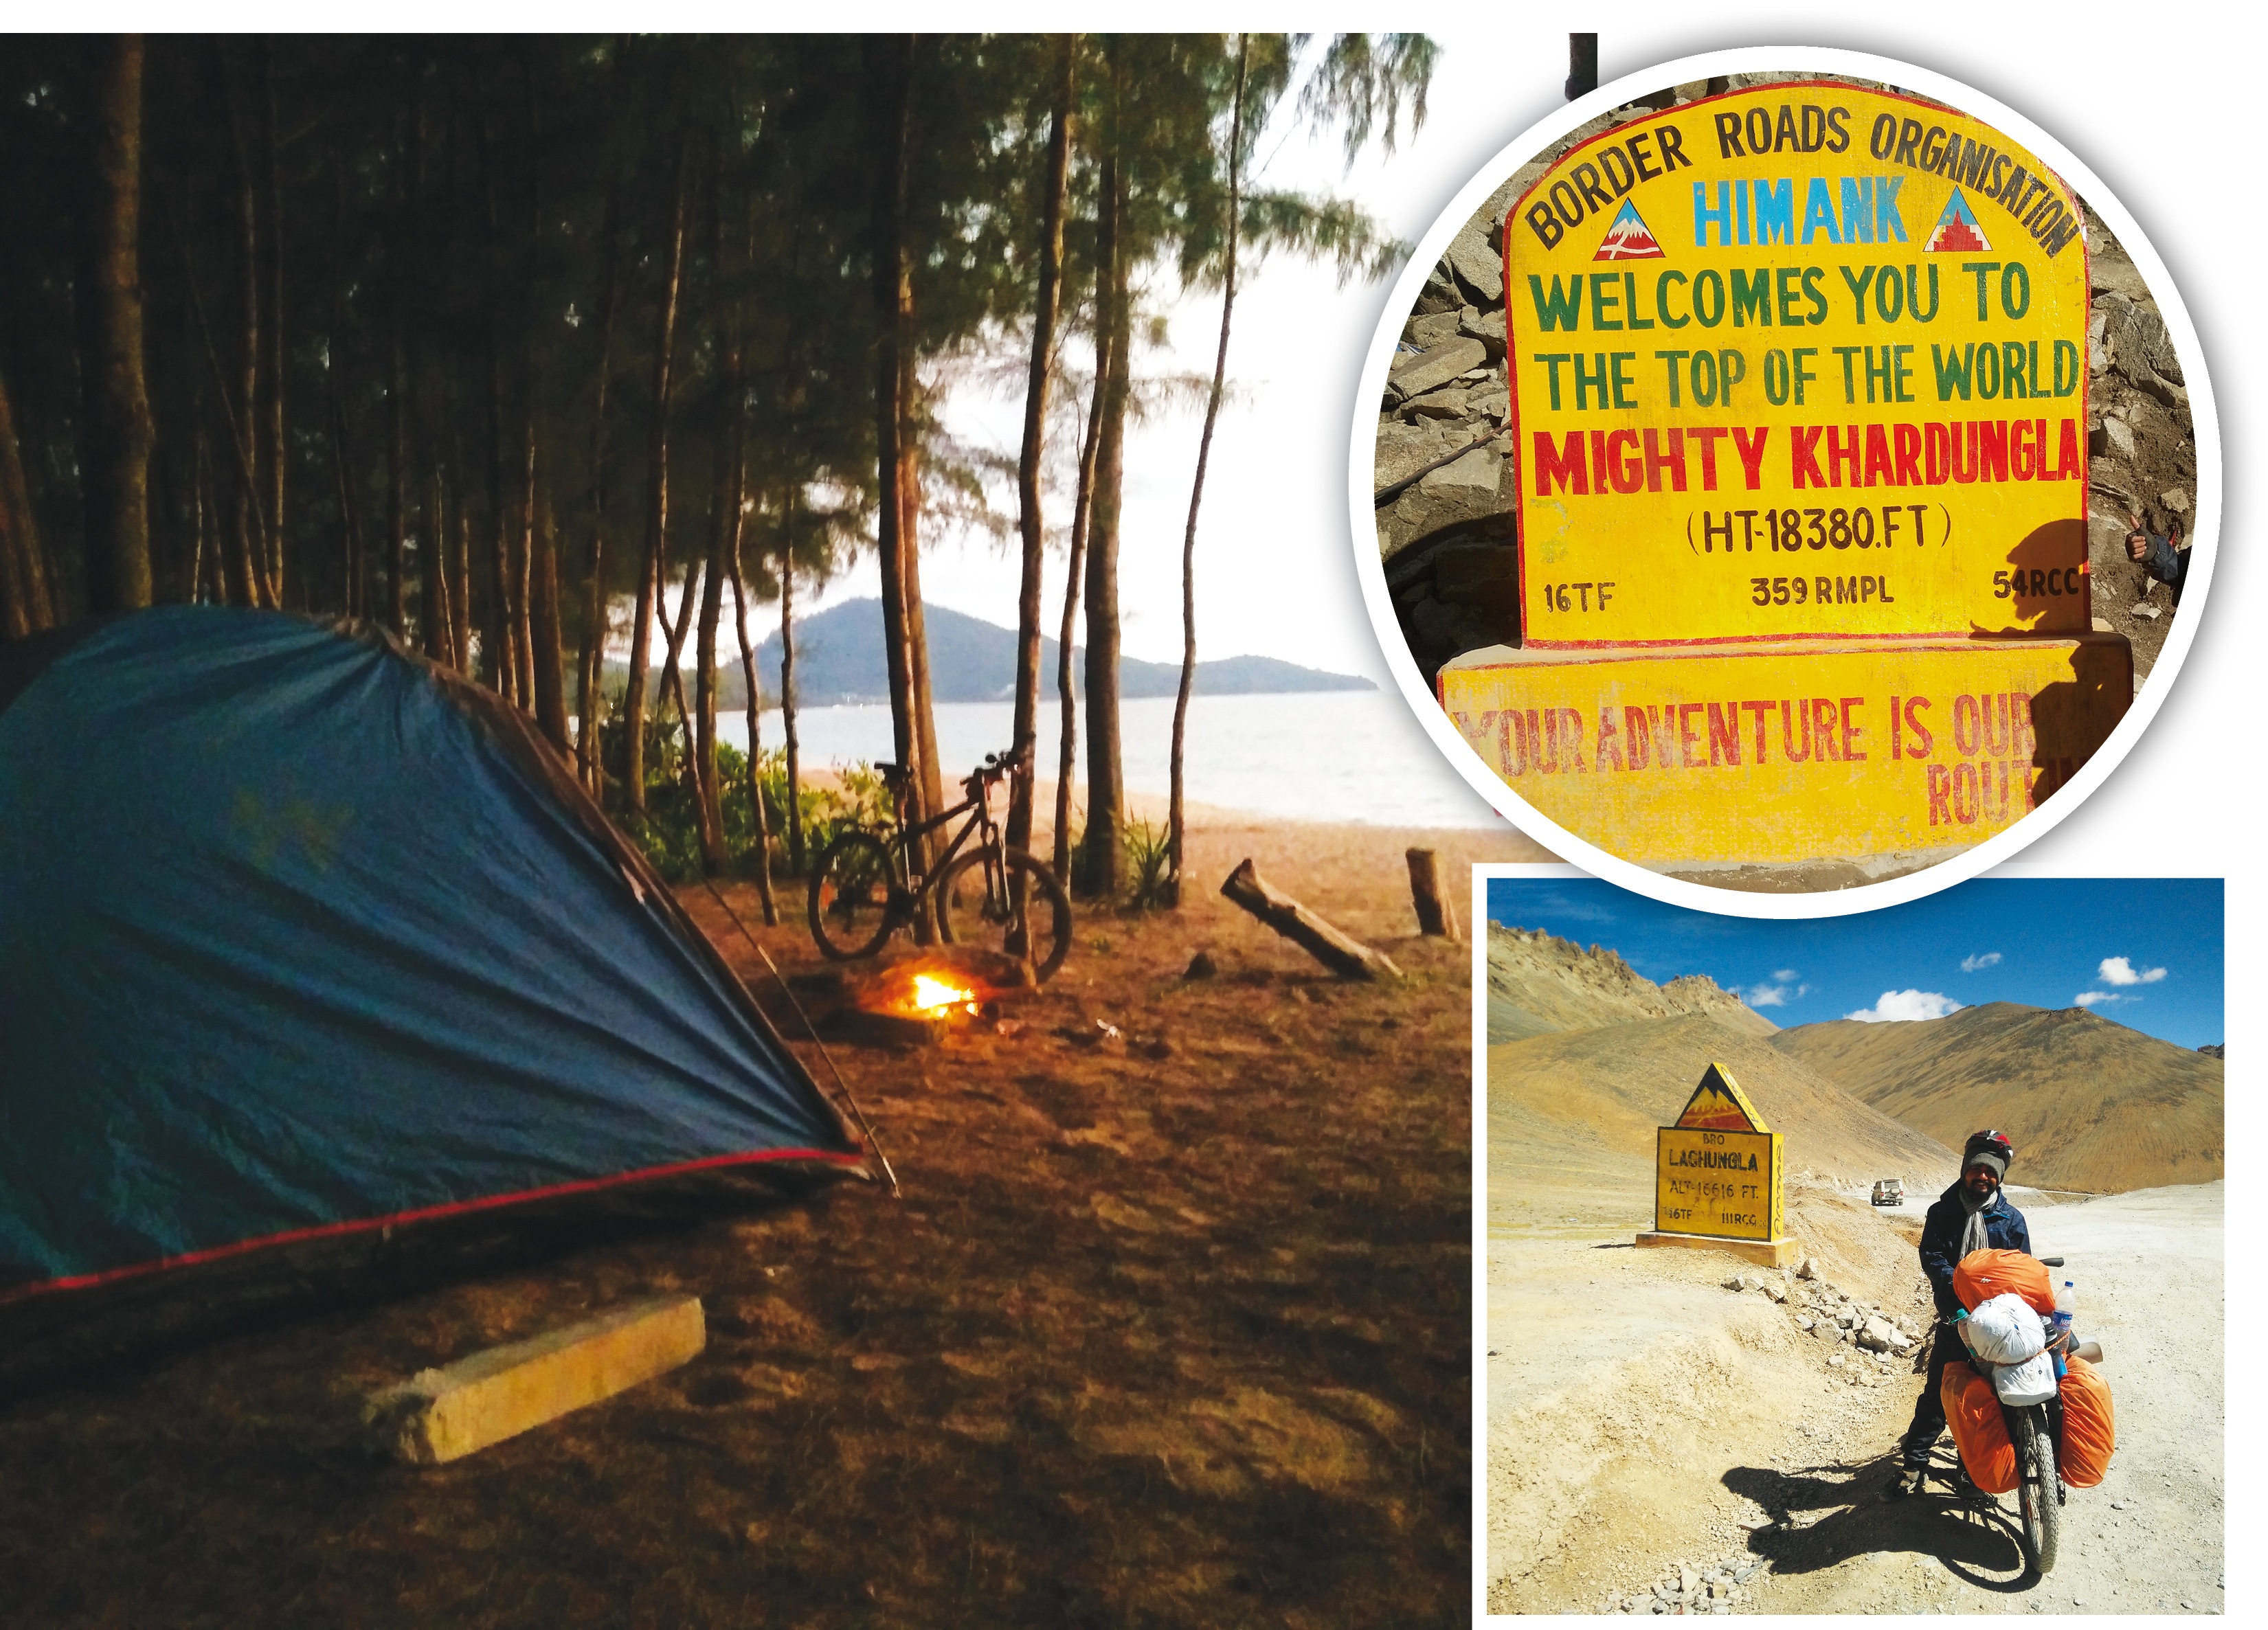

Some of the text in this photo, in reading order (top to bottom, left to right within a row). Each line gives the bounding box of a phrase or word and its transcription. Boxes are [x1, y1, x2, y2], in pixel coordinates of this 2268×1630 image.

[1524, 104, 2081, 260] BORDER ROADS ORGANISATION
[1692, 176, 1909, 247] HIMANK
[1529, 262, 2030, 332] WELCOMES YOU TO
[1534, 339, 2079, 411] THE TOP OF THE WORLD
[1534, 418, 2082, 497] MIGHTY KHARDUNGLA
[1545, 567, 2078, 613] 16TF 359 RMPL 54RCC
[1452, 691, 2037, 778] YOUR ADVENTURE IS OUR
[1703, 1133, 1725, 1146] BRO
